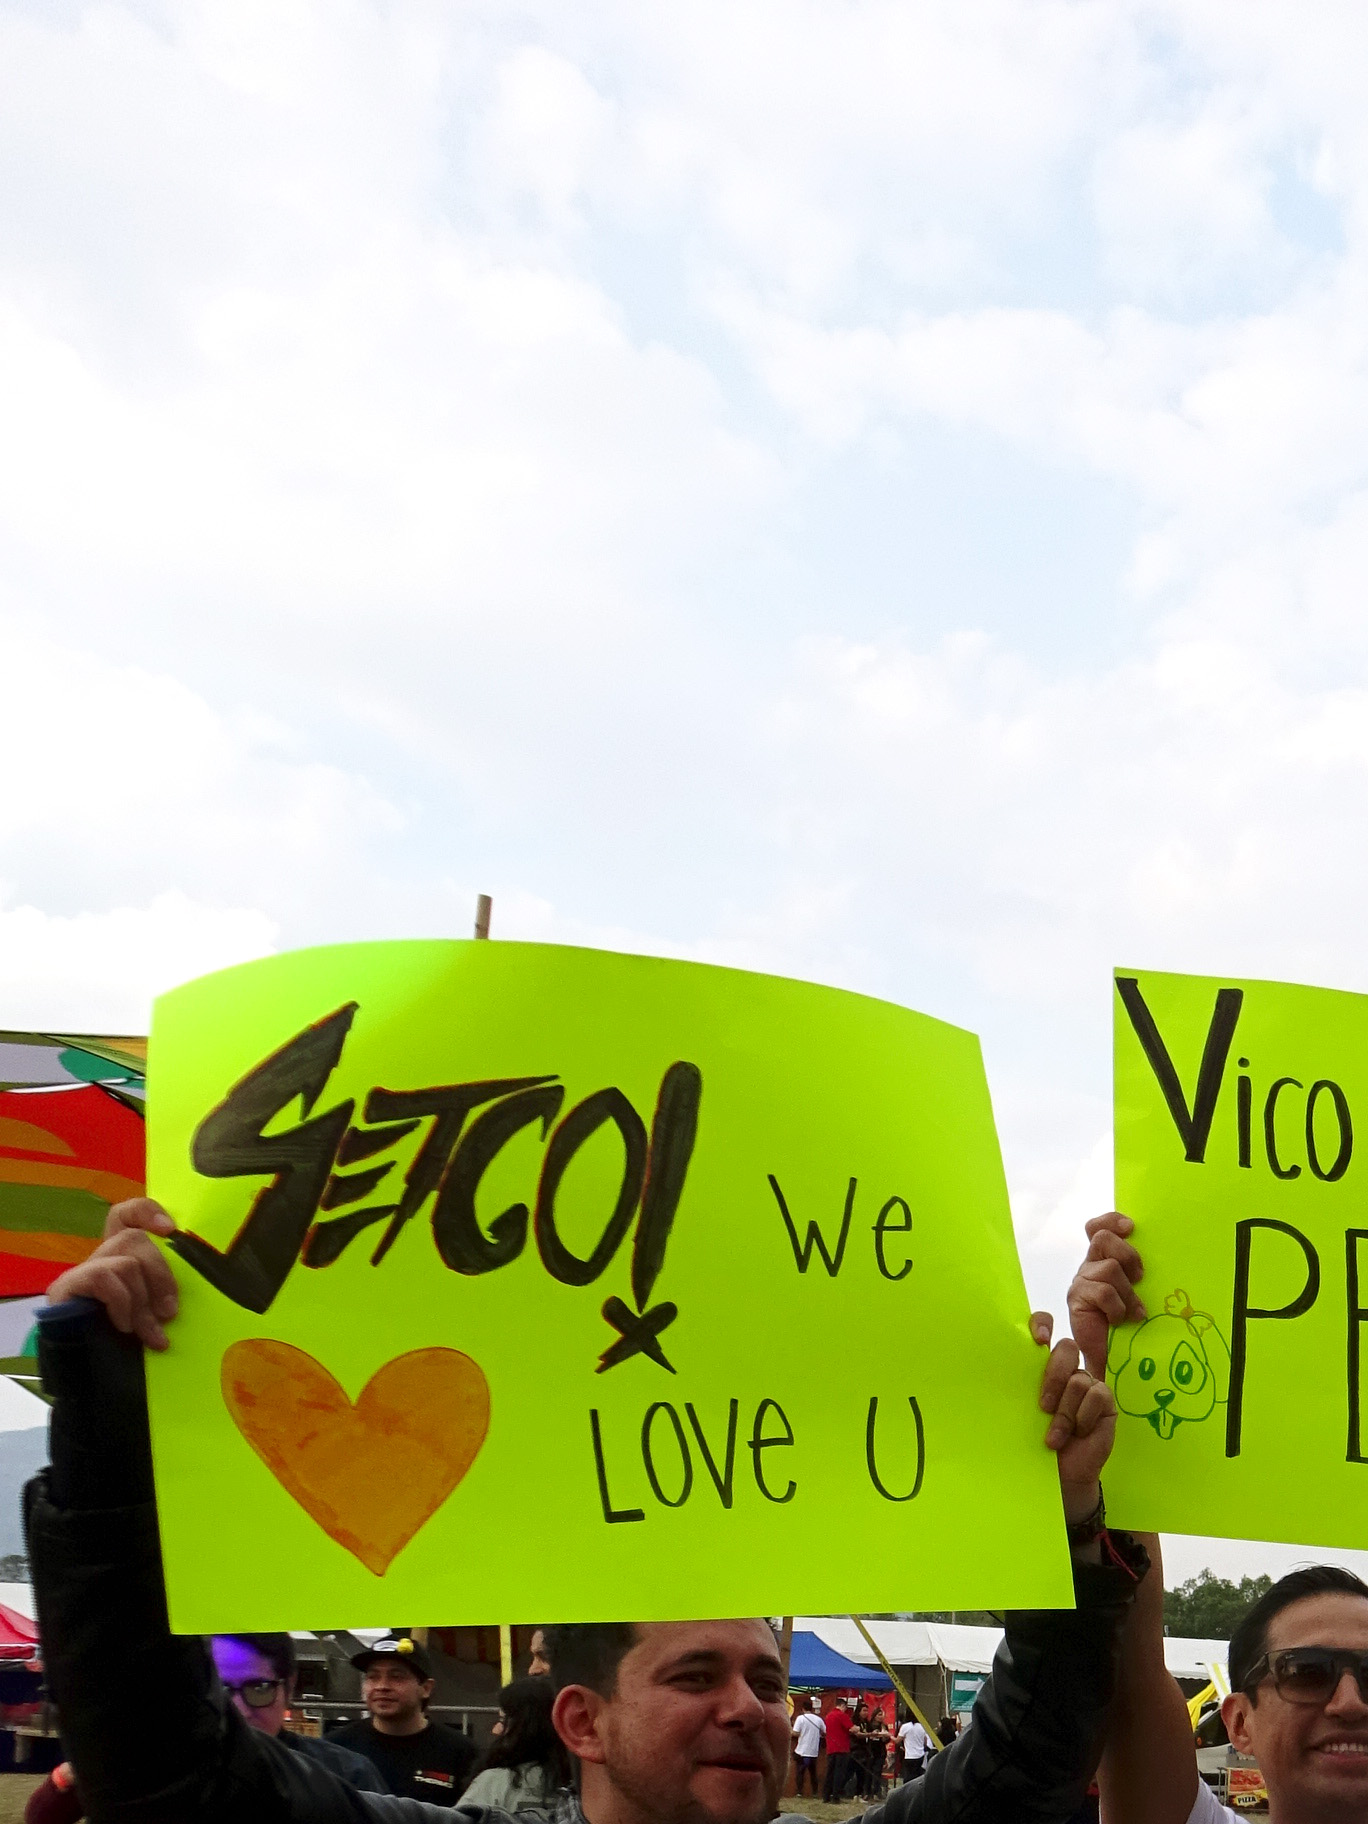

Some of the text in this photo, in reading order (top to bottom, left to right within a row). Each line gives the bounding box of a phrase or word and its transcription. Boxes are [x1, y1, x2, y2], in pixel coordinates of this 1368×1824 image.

[767, 1174, 914, 1281] We
[866, 1396, 926, 1502] U
[1237, 1796, 1257, 1804] PIZZA
